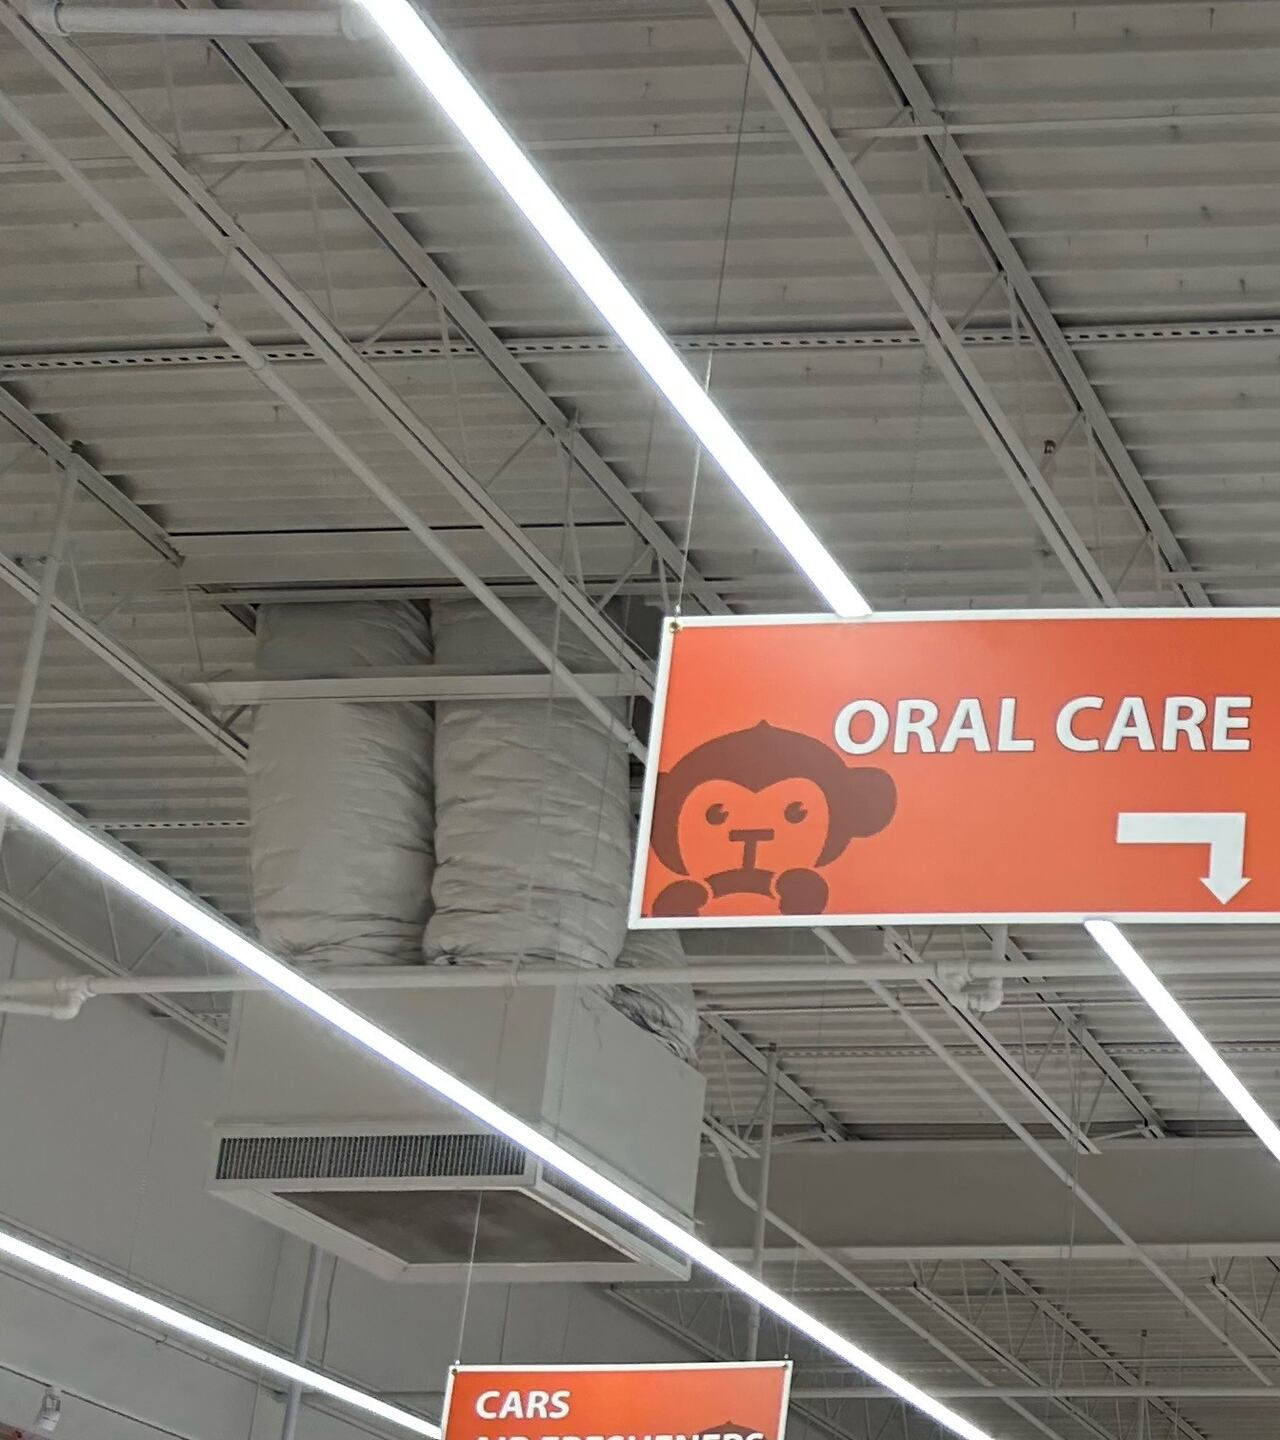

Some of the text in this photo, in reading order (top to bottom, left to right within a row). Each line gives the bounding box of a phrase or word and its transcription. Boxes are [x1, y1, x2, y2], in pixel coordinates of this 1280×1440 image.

[834, 695, 1252, 754] ORAL CARE
[475, 1391, 570, 1419] CARS
